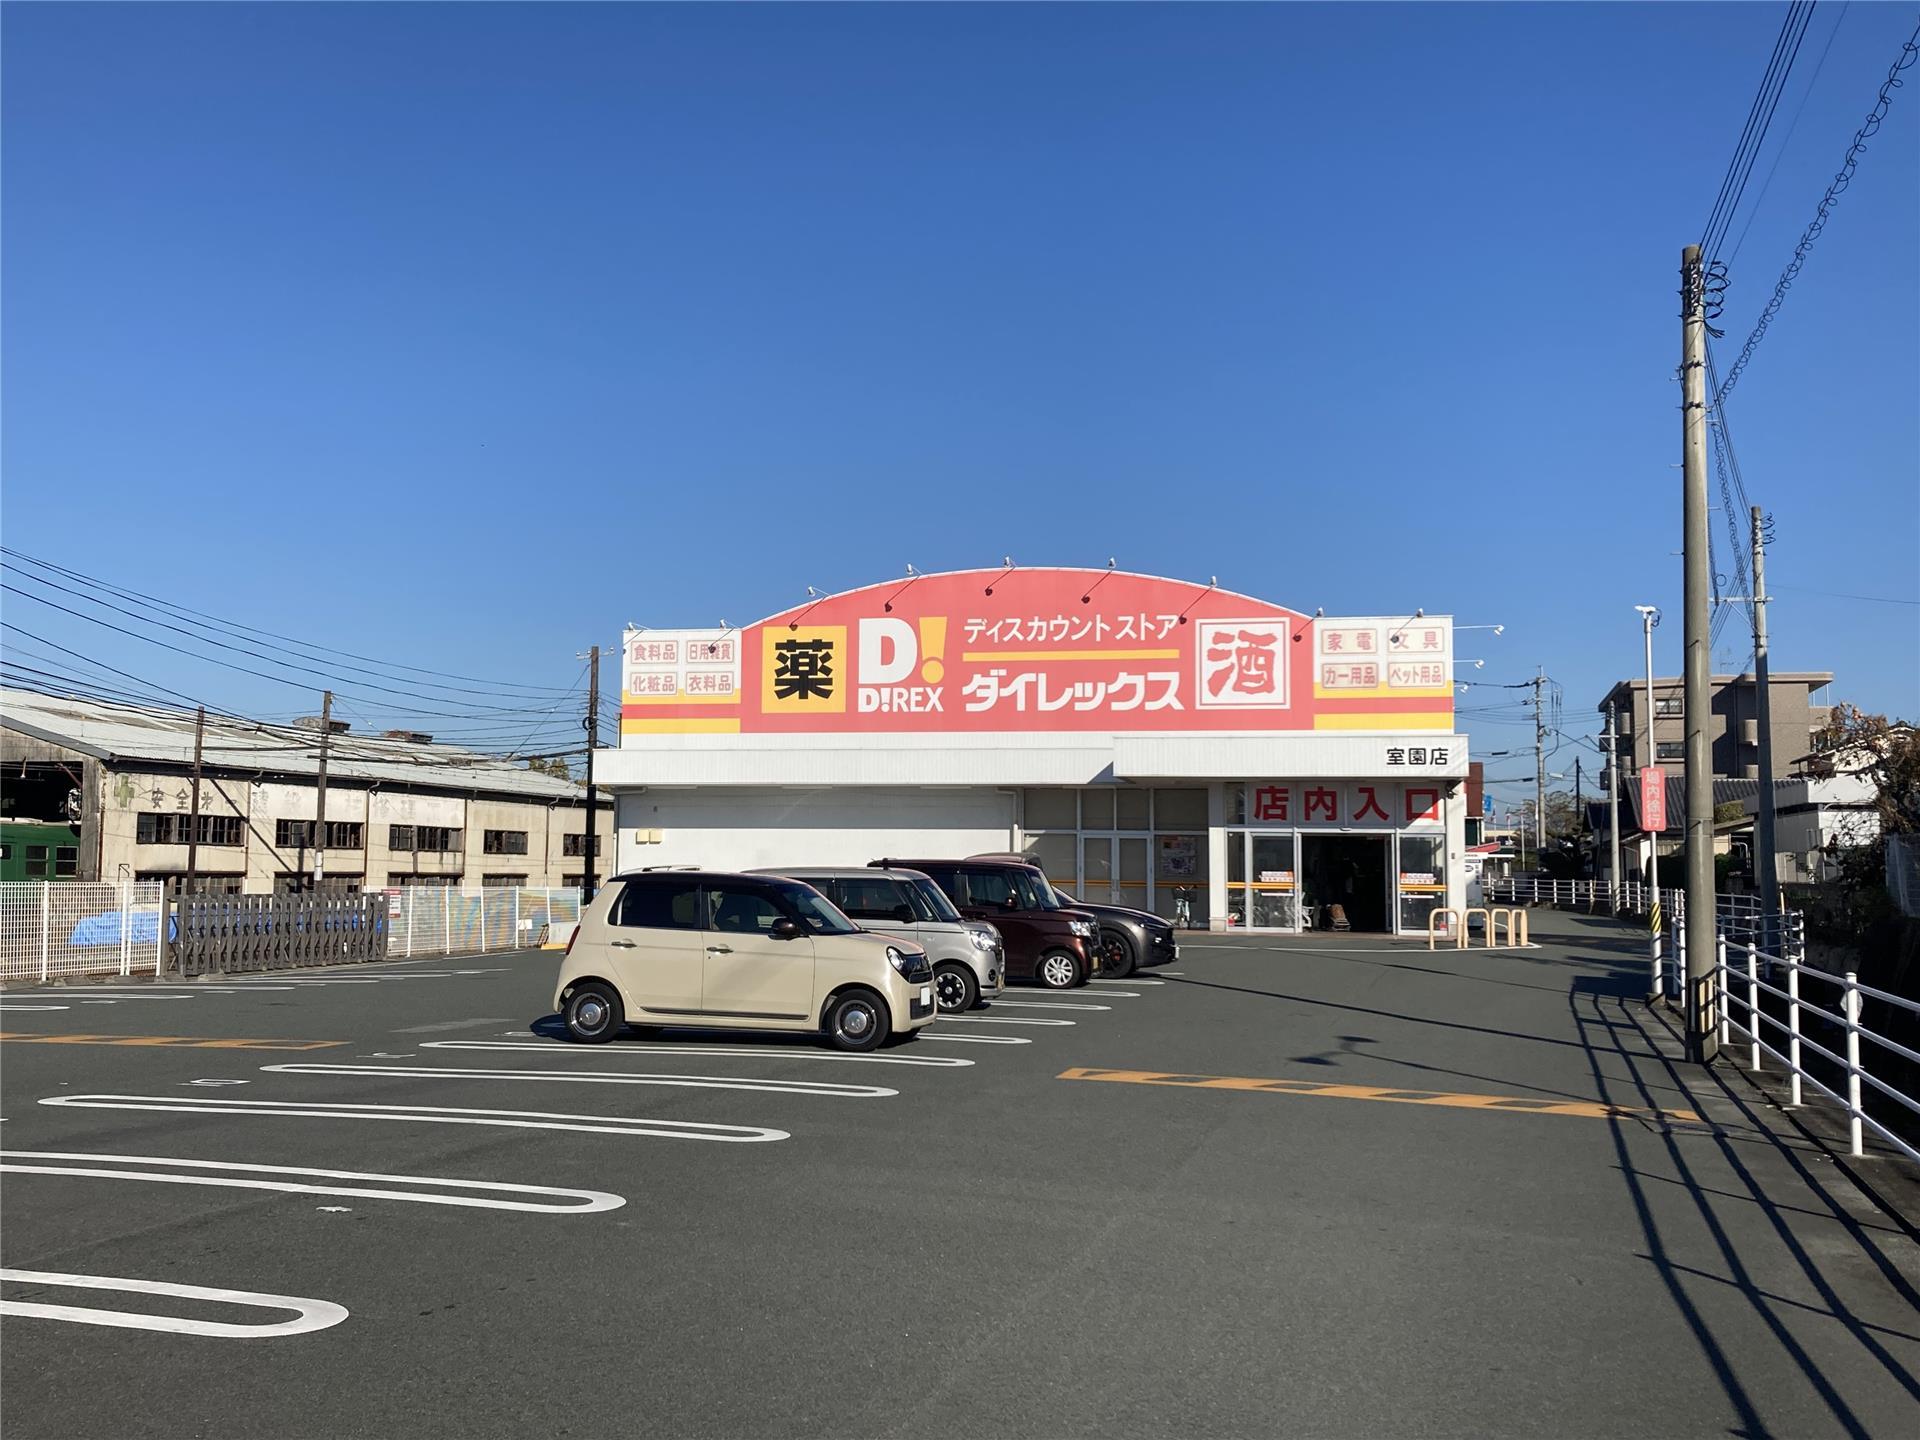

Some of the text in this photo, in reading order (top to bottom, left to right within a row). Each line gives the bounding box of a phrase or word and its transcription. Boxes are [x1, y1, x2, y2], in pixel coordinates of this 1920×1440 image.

[1327, 632, 1372, 651] 家電
[1392, 631, 1438, 650] 文具
[634, 644, 675, 660] 食料品
[774, 639, 834, 700] 薬
[1206, 630, 1278, 698] 酒
[633, 675, 675, 692] 化粧品
[689, 674, 731, 692] 衣料品
[1325, 666, 1376, 685] カー用品
[1391, 665, 1441, 684] ペット用品
[962, 669, 1185, 712] ダイレックス
[1386, 747, 1449, 766] 室園店
[1254, 786, 1440, 822] 店内入口
